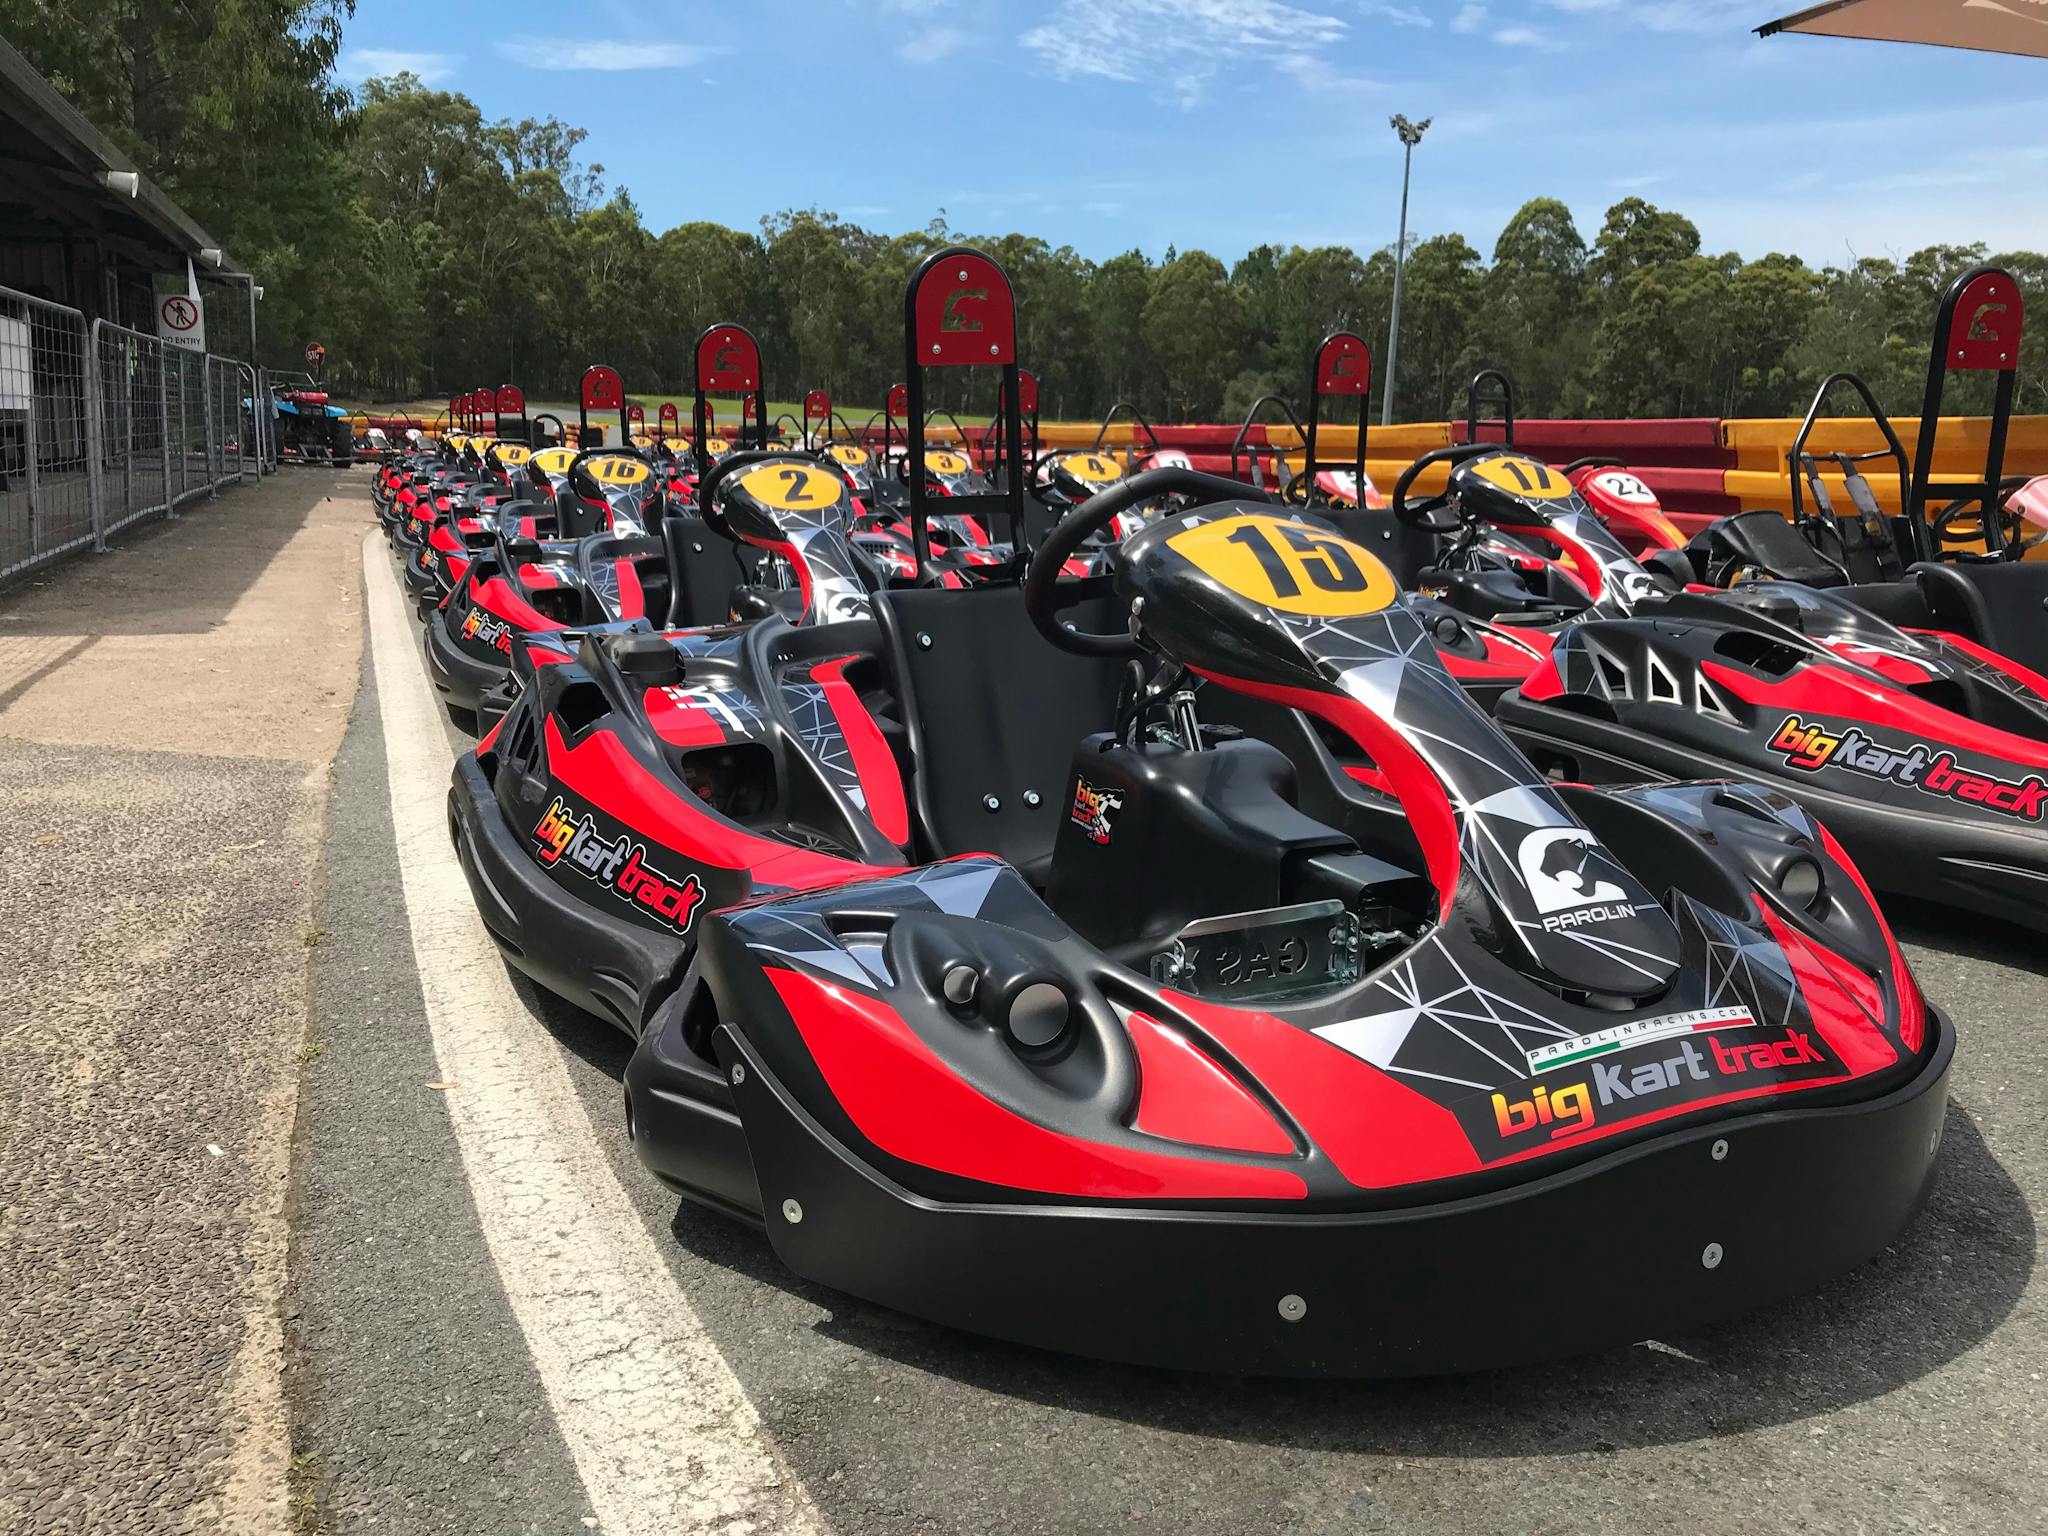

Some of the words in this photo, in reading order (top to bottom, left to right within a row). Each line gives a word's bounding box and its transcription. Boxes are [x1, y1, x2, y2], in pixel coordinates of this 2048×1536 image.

[175, 336, 201, 345] ENTRY
[602, 460, 637, 478] 16
[778, 469, 814, 503] 2
[1501, 461, 1552, 491] 17
[1606, 477, 1650, 496] 22
[1226, 524, 1369, 599] 15
[1772, 718, 1840, 767] big
[1923, 757, 2048, 818] track
[1074, 779, 1100, 816] big
[535, 802, 577, 863] big
[617, 851, 701, 927] track
[1541, 903, 1637, 933] PAROLIN
[1530, 1008, 1749, 1061] PAROLINRACING.COM
[1491, 1081, 1597, 1140] big
[1707, 1027, 1827, 1076] track
